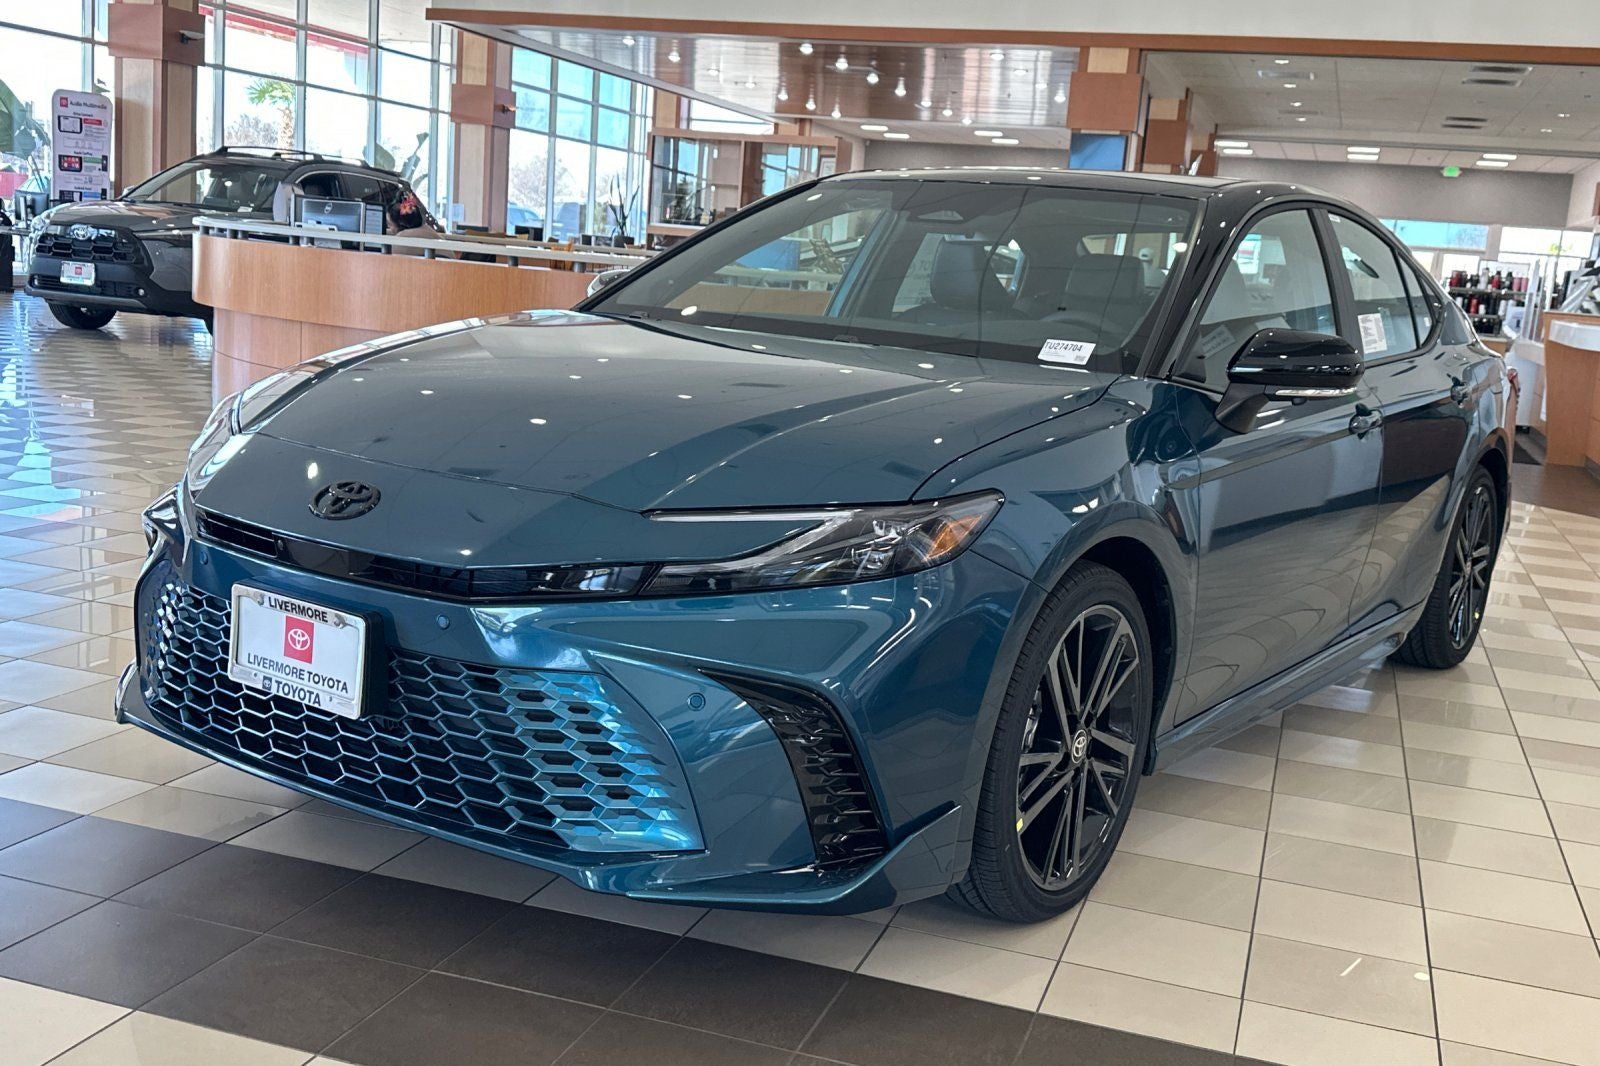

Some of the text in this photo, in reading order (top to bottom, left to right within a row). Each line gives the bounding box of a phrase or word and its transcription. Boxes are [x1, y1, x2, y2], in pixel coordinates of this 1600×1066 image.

[1045, 342, 1083, 351] TU274704
[268, 596, 329, 623] LIVERMORE
[247, 652, 348, 694] LIVERMORE TOYOTA
[274, 679, 321, 707] TOYOTA
